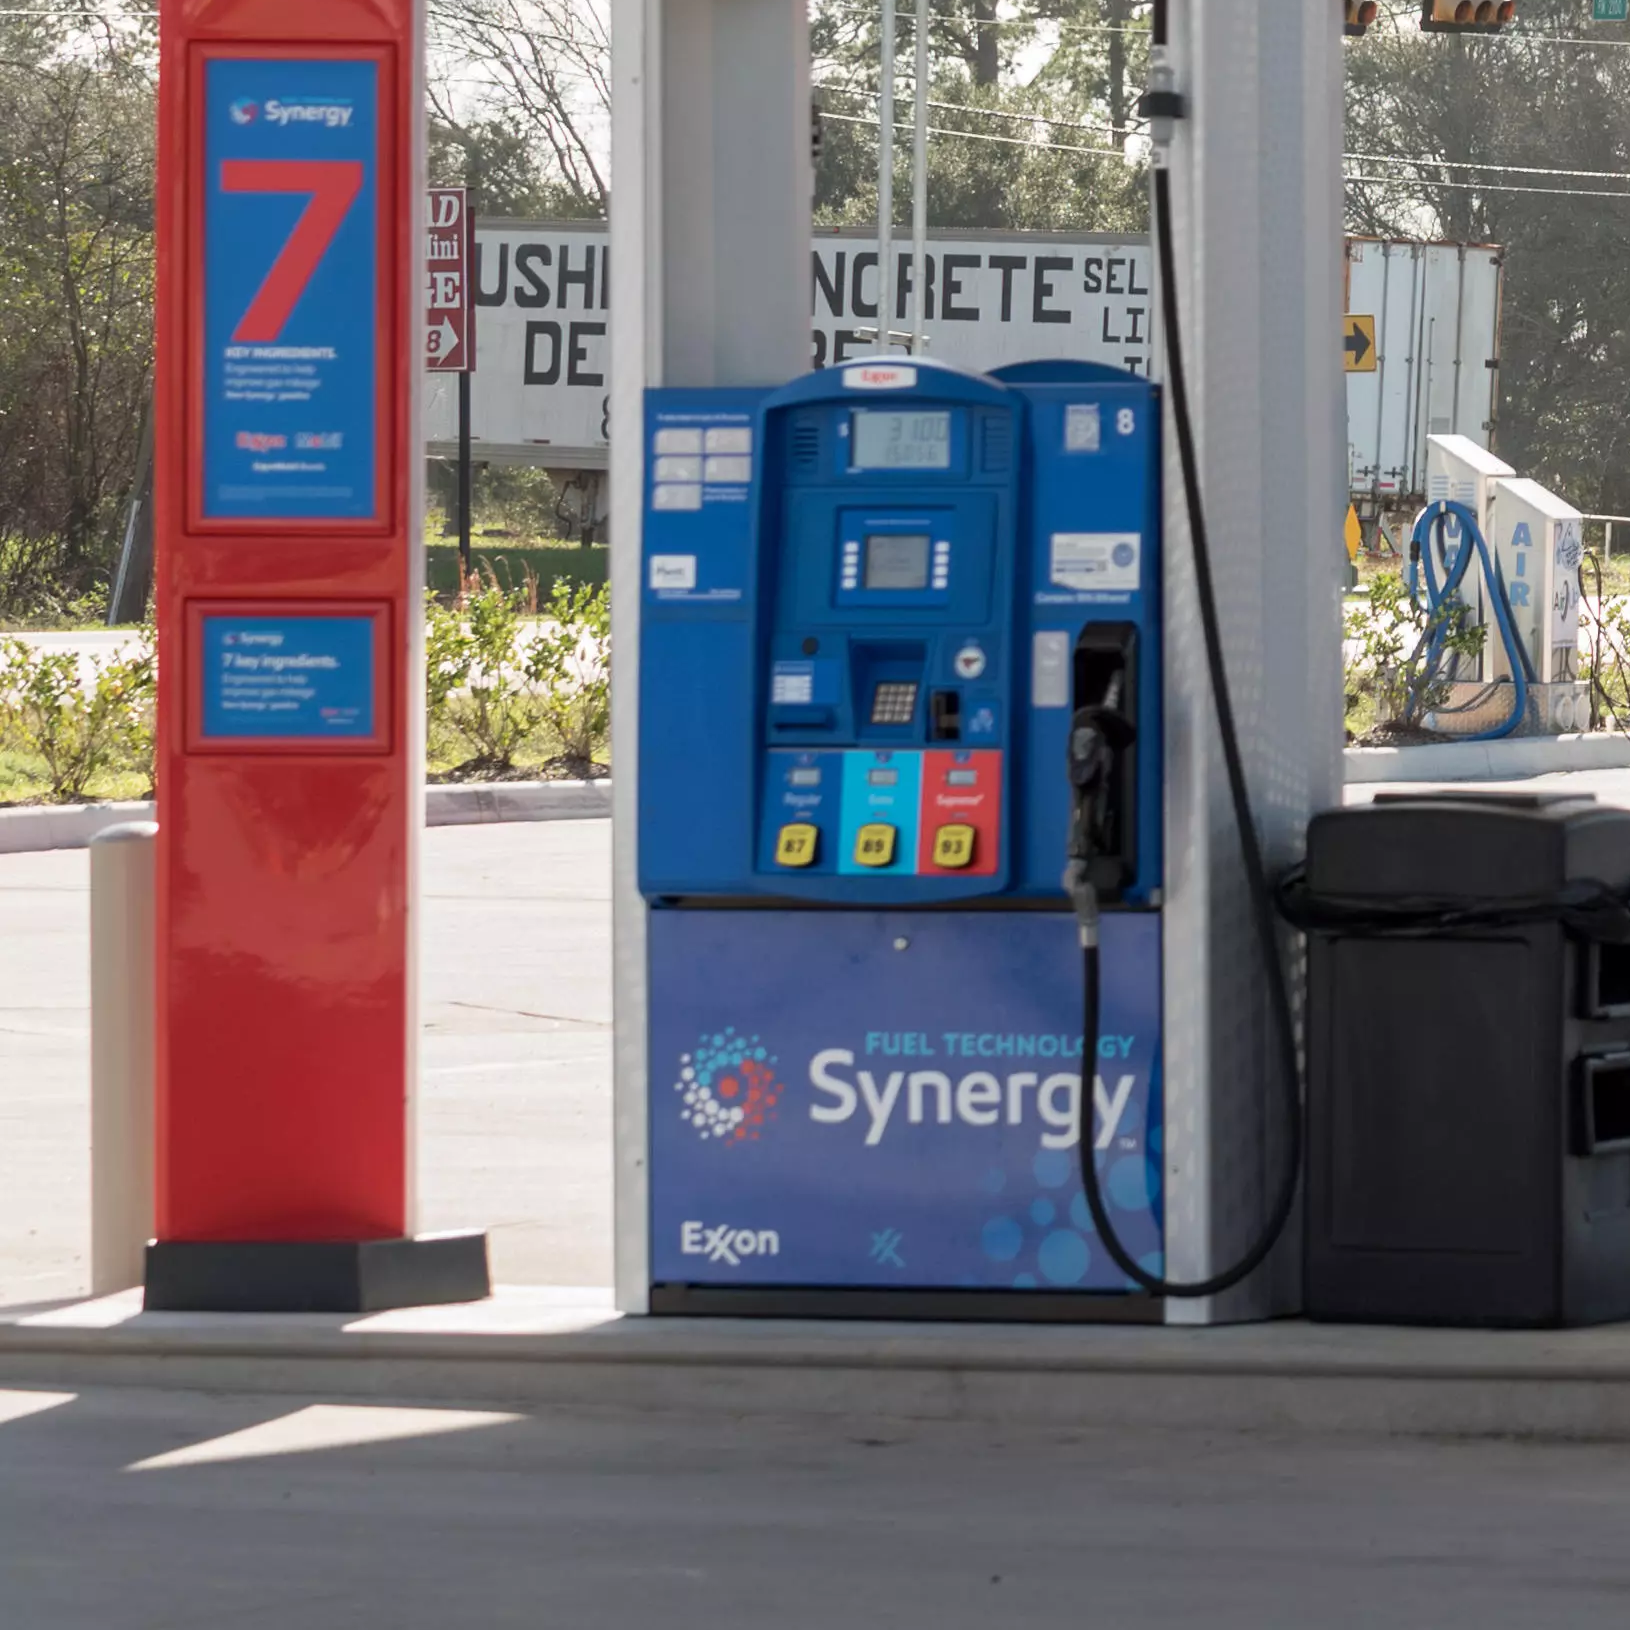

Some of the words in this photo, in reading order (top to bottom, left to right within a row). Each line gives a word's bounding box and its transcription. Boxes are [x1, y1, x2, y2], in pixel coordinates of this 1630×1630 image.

[264, 99, 353, 128] Synergy
[220, 160, 363, 342] 7
[1117, 407, 1135, 435] 8
[1510, 522, 1532, 607] AIR
[784, 838, 806, 854] 87
[862, 838, 885, 855] 89
[941, 839, 964, 856] 93
[865, 1032, 934, 1056] FUEL
[808, 1049, 1135, 1149] Synergy
[681, 1221, 779, 1266] Exxon
